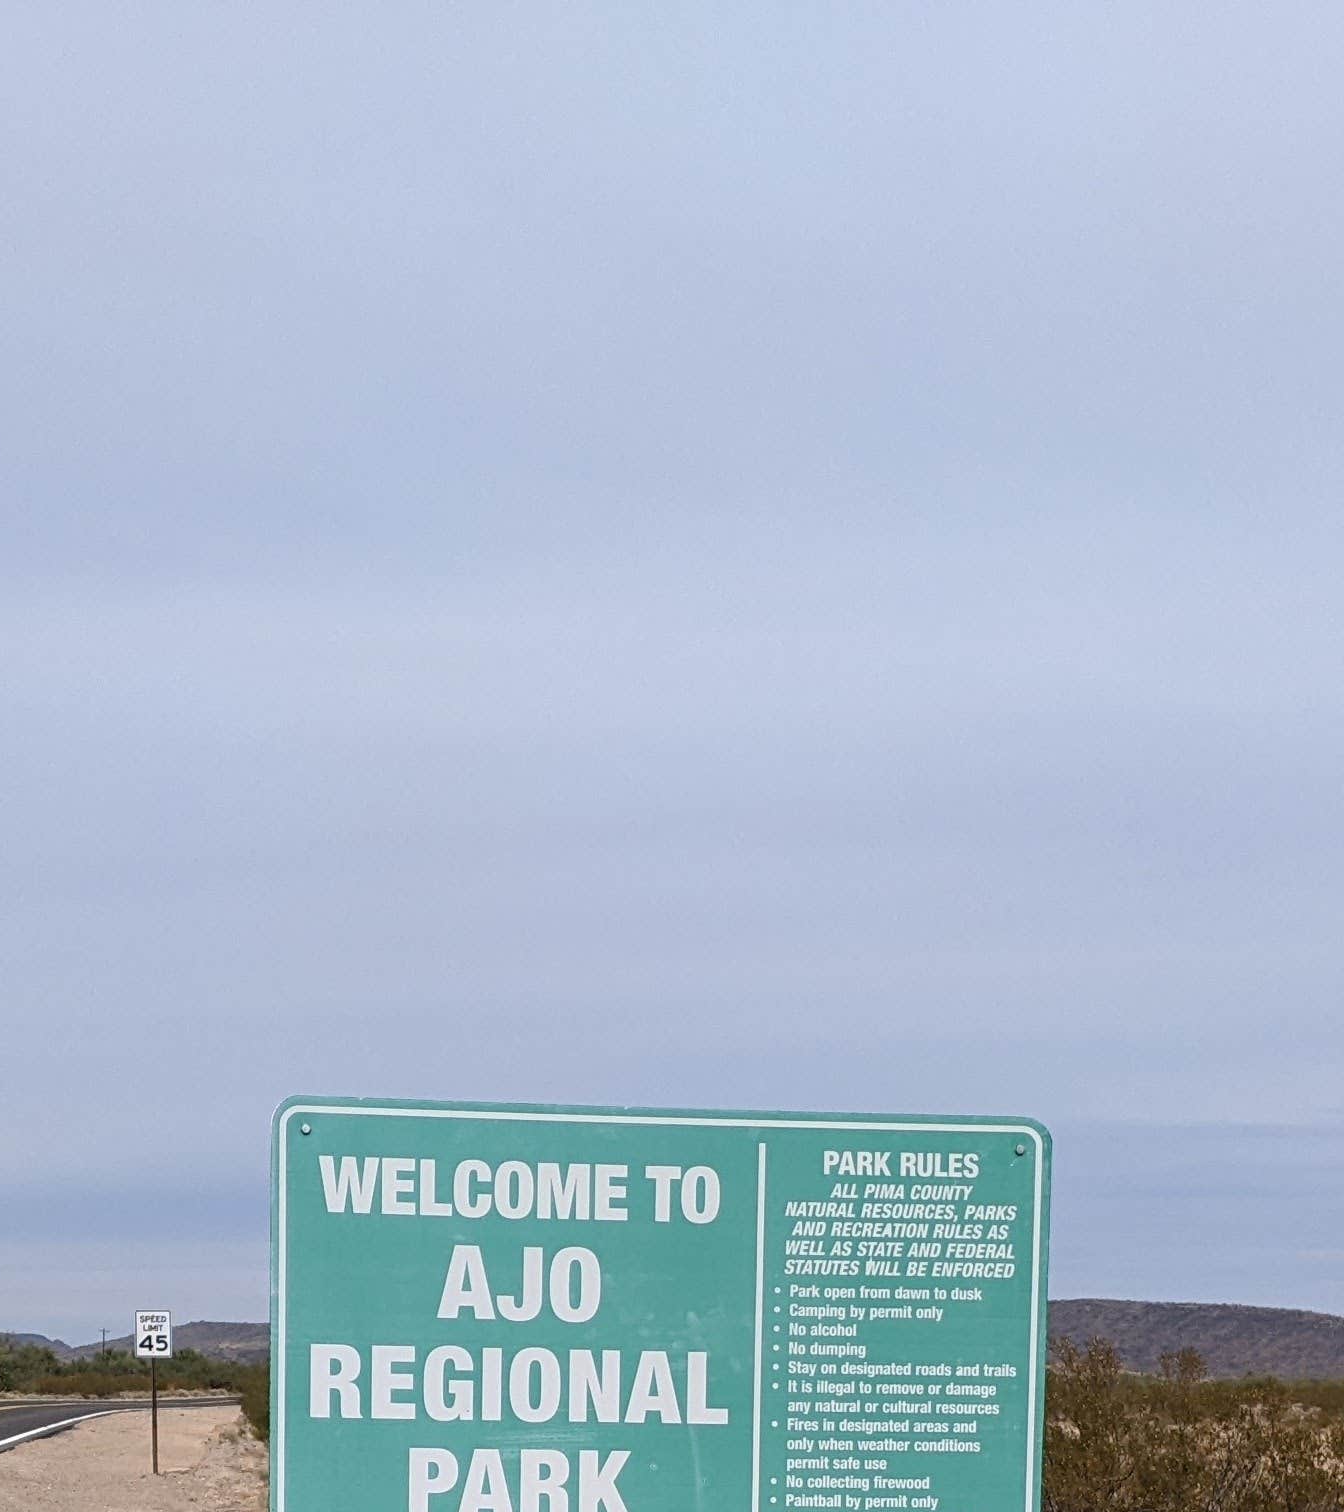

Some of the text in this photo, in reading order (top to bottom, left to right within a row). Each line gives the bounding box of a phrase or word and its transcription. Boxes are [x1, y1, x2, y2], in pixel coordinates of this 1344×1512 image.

[824, 1151, 979, 1178] PARK RULES
[319, 1156, 720, 1224] WELCOME TO
[831, 1184, 973, 1200] ALL PIMA COUNTY
[785, 1202, 1017, 1222] NATURAL RESOURCES, PARKS
[792, 1221, 1008, 1239] AND RECREATION RULES AS
[786, 1240, 1014, 1259] WELL AS STATE AND FEDERAL
[785, 1260, 1015, 1278] STATUTES WILL BE ENFORCED
[437, 1245, 601, 1322] AJO
[790, 1284, 982, 1300] Park open from dawn to dusk
[140, 1315, 167, 1323] SPEED
[790, 1304, 943, 1321] Camping by permit only
[789, 1323, 856, 1336] No alcohol
[139, 1335, 168, 1351] 45
[789, 1342, 866, 1358] No dumping
[789, 1361, 1016, 1377] Stay on designated roads and trails
[310, 1344, 728, 1424] REGIONAL
[788, 1380, 996, 1398] It is illegal to remove or damage
[788, 1400, 999, 1414] any natural or cultural resources
[788, 1418, 976, 1434] Fires in designated areas and
[787, 1437, 980, 1452] only when weather conditions
[787, 1456, 887, 1471] permit safe use
[787, 1475, 929, 1491] No collecting firewood
[786, 1494, 938, 1510] Paintball by permit only
